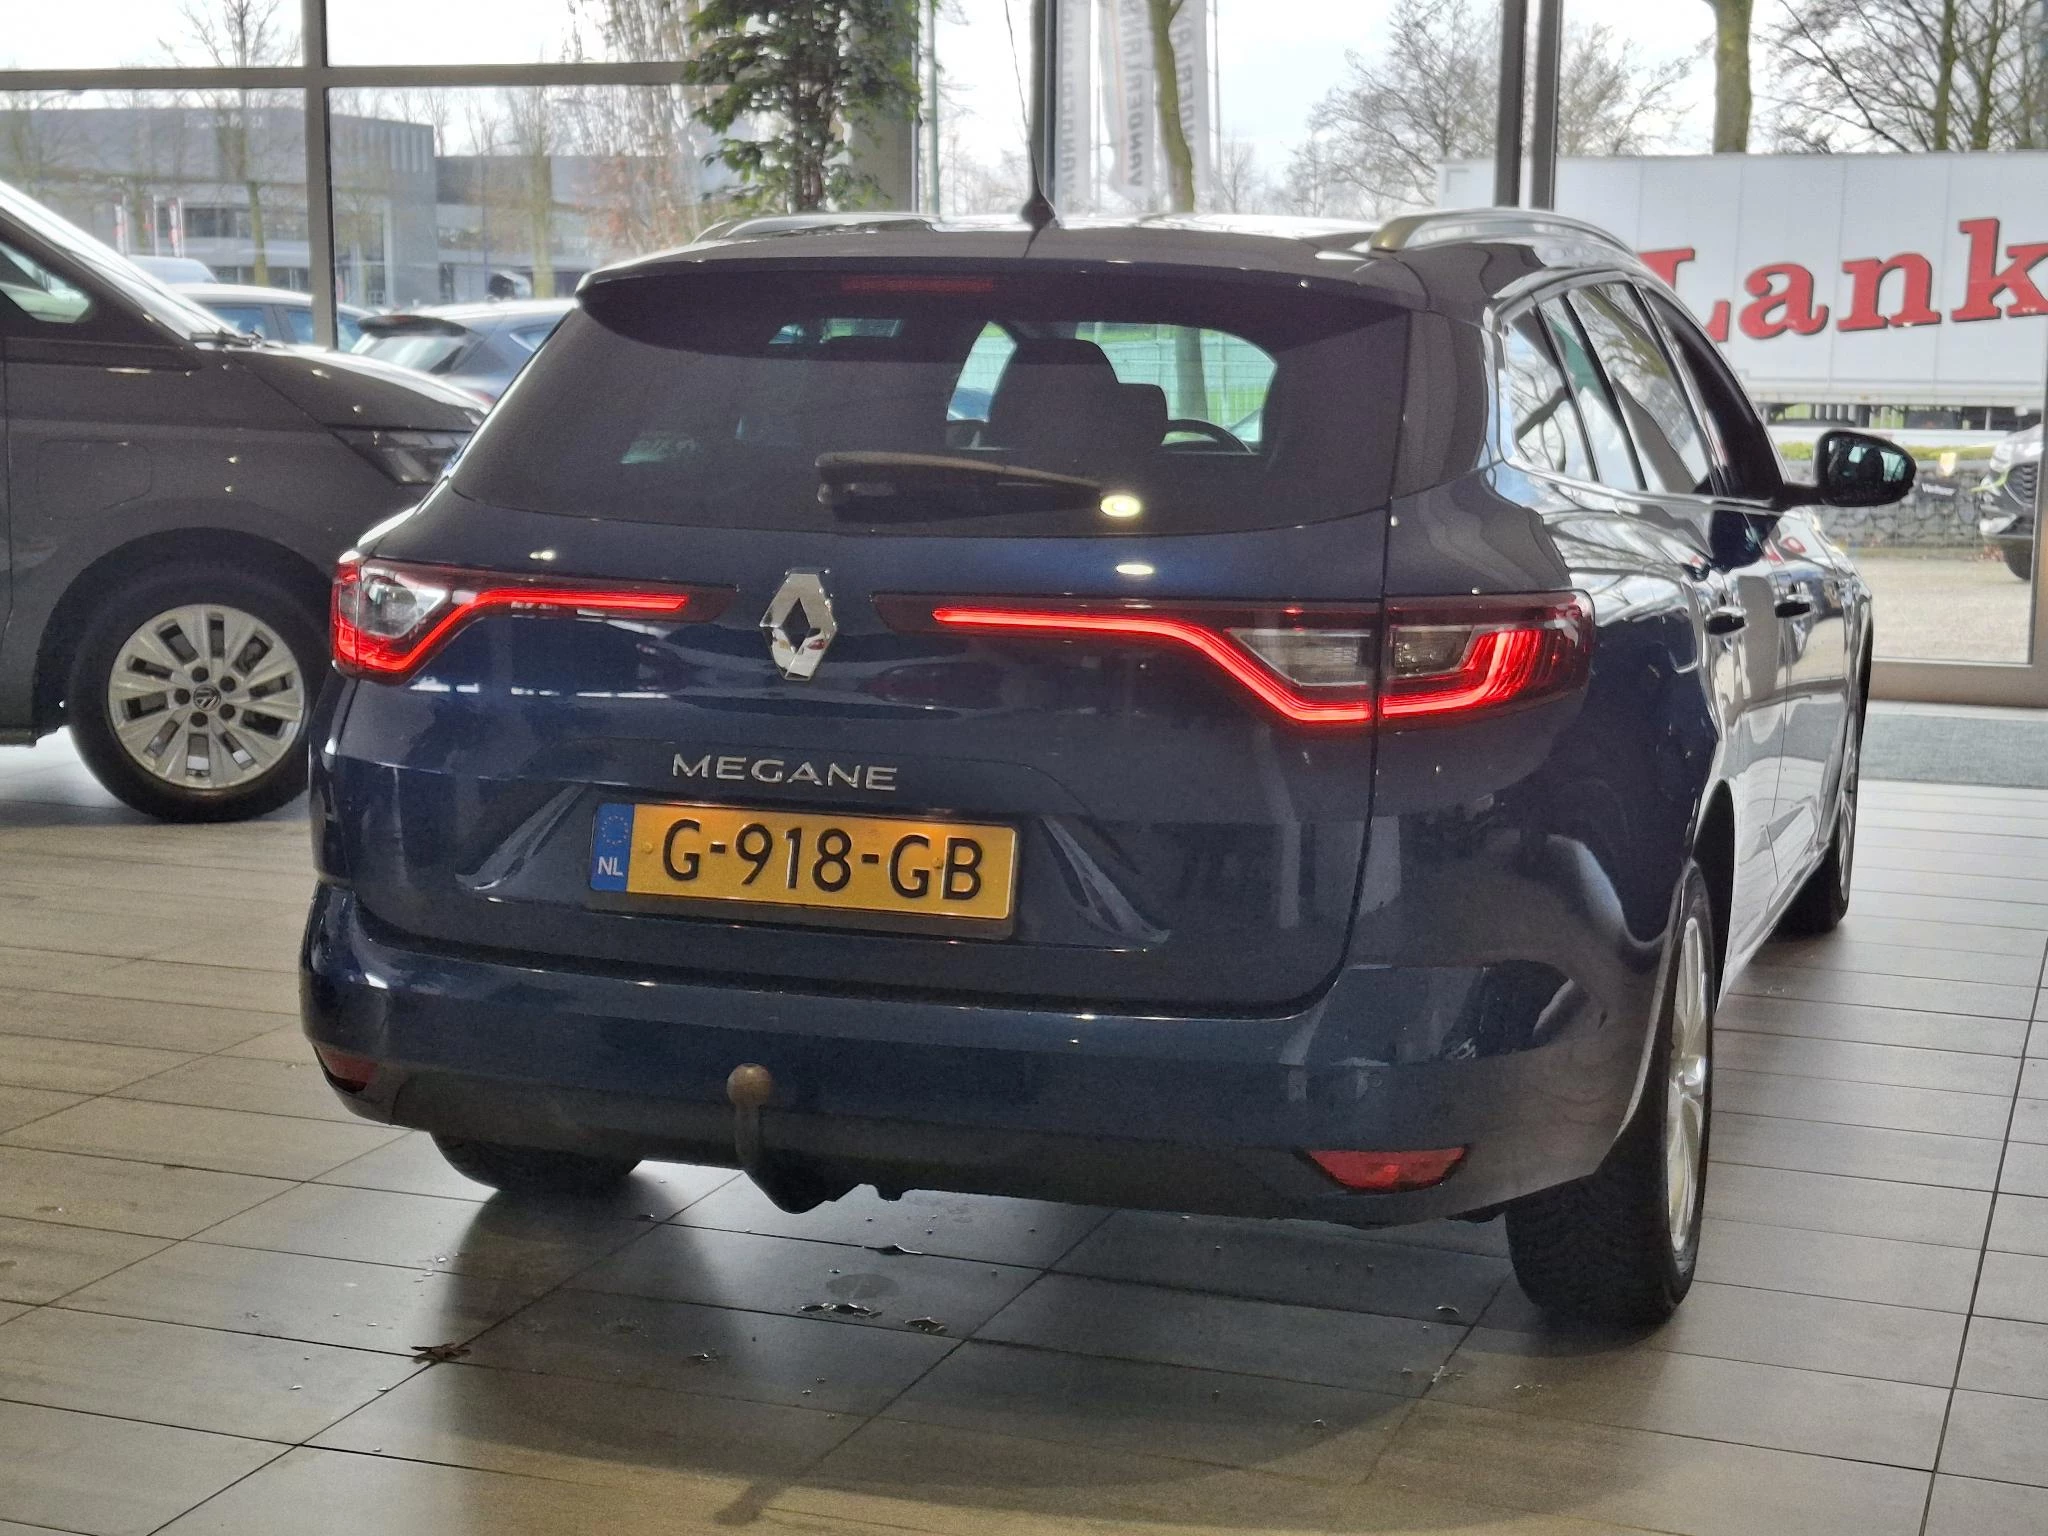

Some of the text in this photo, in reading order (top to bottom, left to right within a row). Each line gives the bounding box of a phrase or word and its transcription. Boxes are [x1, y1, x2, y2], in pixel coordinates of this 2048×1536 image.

[672, 753, 897, 791] MEGANE
[597, 855, 624, 877] NL
[662, 818, 984, 901] G-918-GB
